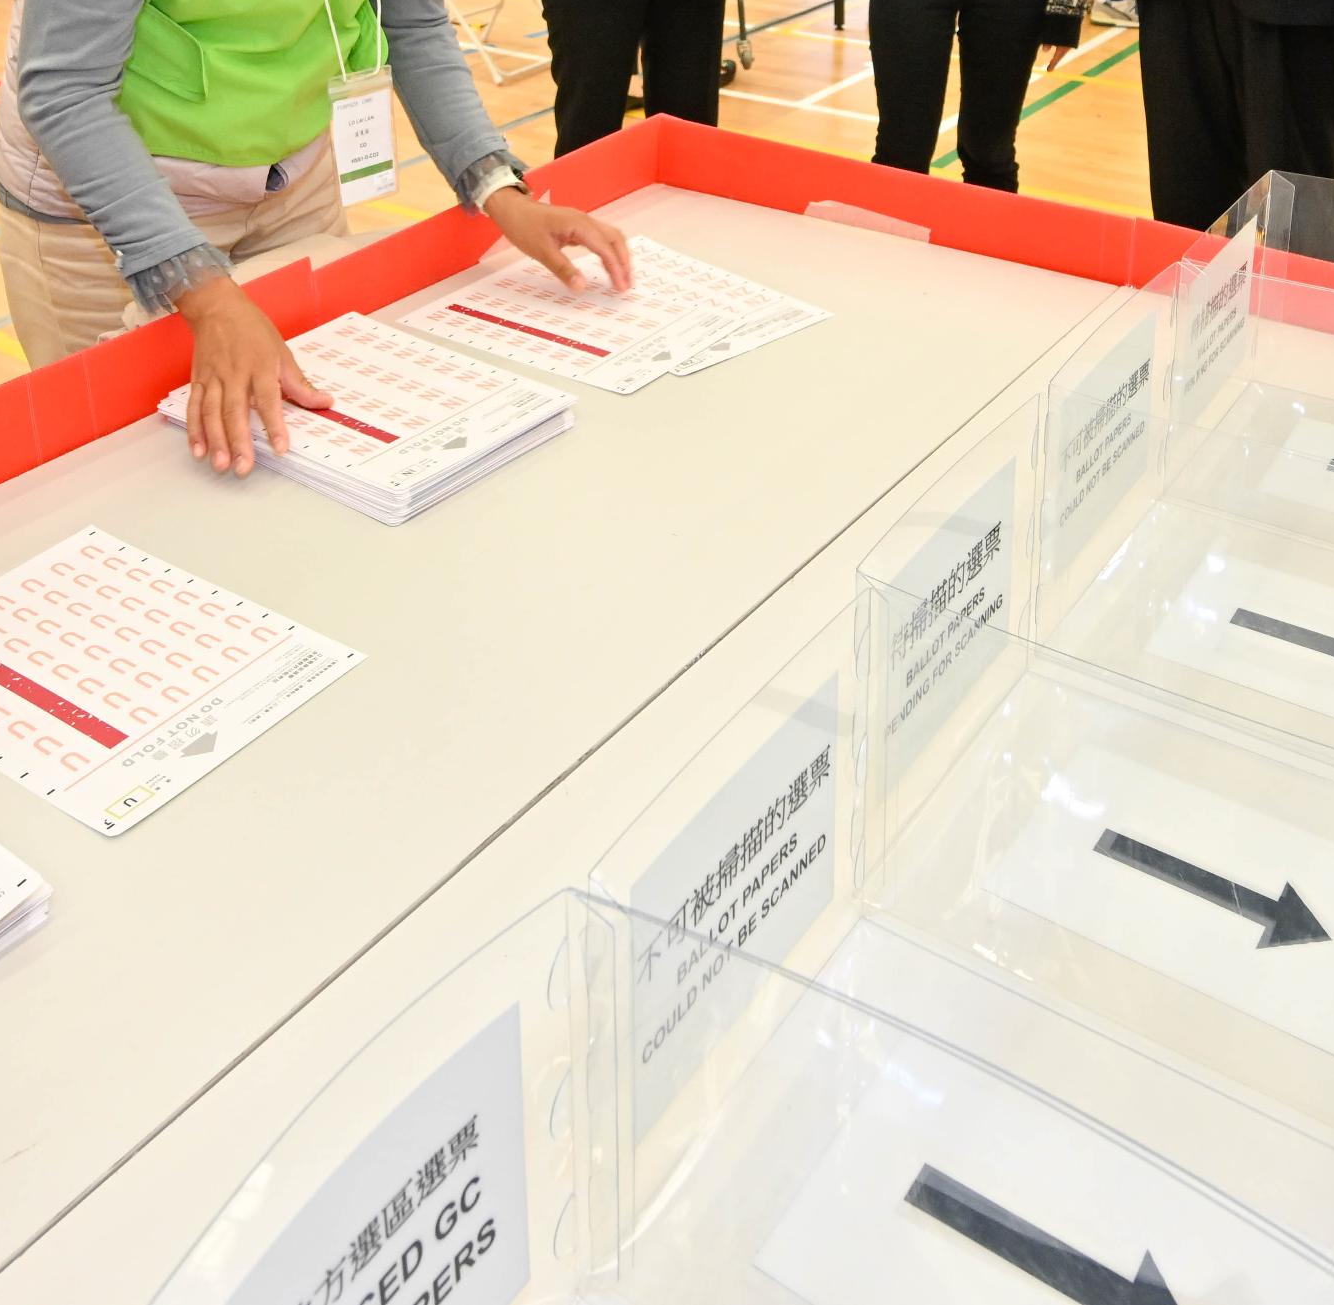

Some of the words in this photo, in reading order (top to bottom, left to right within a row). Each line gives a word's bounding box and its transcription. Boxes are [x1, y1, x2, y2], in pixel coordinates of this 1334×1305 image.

[1075, 445, 1103, 483] BALLOT
[1104, 413, 1132, 450] PAPERS
[1059, 489, 1084, 528] COULD
[1086, 470, 1101, 496] NOT
[1102, 456, 1111, 476] BE
[1113, 421, 1145, 463] SCANNED
[79, 545, 106, 560] U
[49, 562, 75, 577] U
[102, 557, 128, 571] U
[72, 572, 99, 588] U
[125, 568, 151, 582] U
[19, 577, 45, 593] U
[95, 585, 121, 601] U
[148, 579, 174, 594] U
[42, 590, 70, 607] U
[119, 596, 144, 612] U
[173, 590, 201, 605] U
[10, 605, 40, 627] U
[65, 601, 92, 617] U
[143, 609, 172, 624] U
[198, 602, 225, 616] U
[35, 620, 60, 637] U
[90, 614, 117, 629] U
[168, 621, 197, 637] U
[223, 615, 251, 629] U
[59, 631, 87, 648] U
[113, 626, 142, 642] U
[195, 634, 221, 648] U
[250, 627, 279, 643] U
[906, 632, 945, 688] BALLOT
[947, 586, 985, 639] PAPERS
[932, 651, 953, 686] FOR
[954, 594, 1003, 658] SCANNING
[2, 636, 32, 654] U
[83, 644, 111, 661] U
[139, 639, 168, 656] U
[27, 650, 55, 667] U
[165, 652, 193, 669] U
[221, 646, 250, 663] U
[50, 664, 80, 680] U
[108, 657, 138, 675] U
[191, 665, 219, 683] U
[76, 677, 106, 694] U
[133, 671, 162, 690] U
[102, 692, 131, 709] U
[161, 685, 190, 703] U
[201, 697, 224, 713] DO
[129, 706, 159, 725] U
[6, 719, 38, 740] U
[167, 714, 201, 738] NOT
[33, 735, 64, 756] U
[121, 737, 166, 768] FOLD
[60, 752, 91, 772] U
[123, 796, 138, 808] U
[637, 744, 831, 984] 不可被掃描的選票
[676, 900, 739, 984] BALLOT
[742, 833, 799, 907] PAPERS
[642, 984, 697, 1065] COULD
[702, 940, 734, 992] NOT
[737, 917, 758, 948] BE
[761, 833, 827, 918] SCANNED
[434, 1176, 482, 1241] GC
